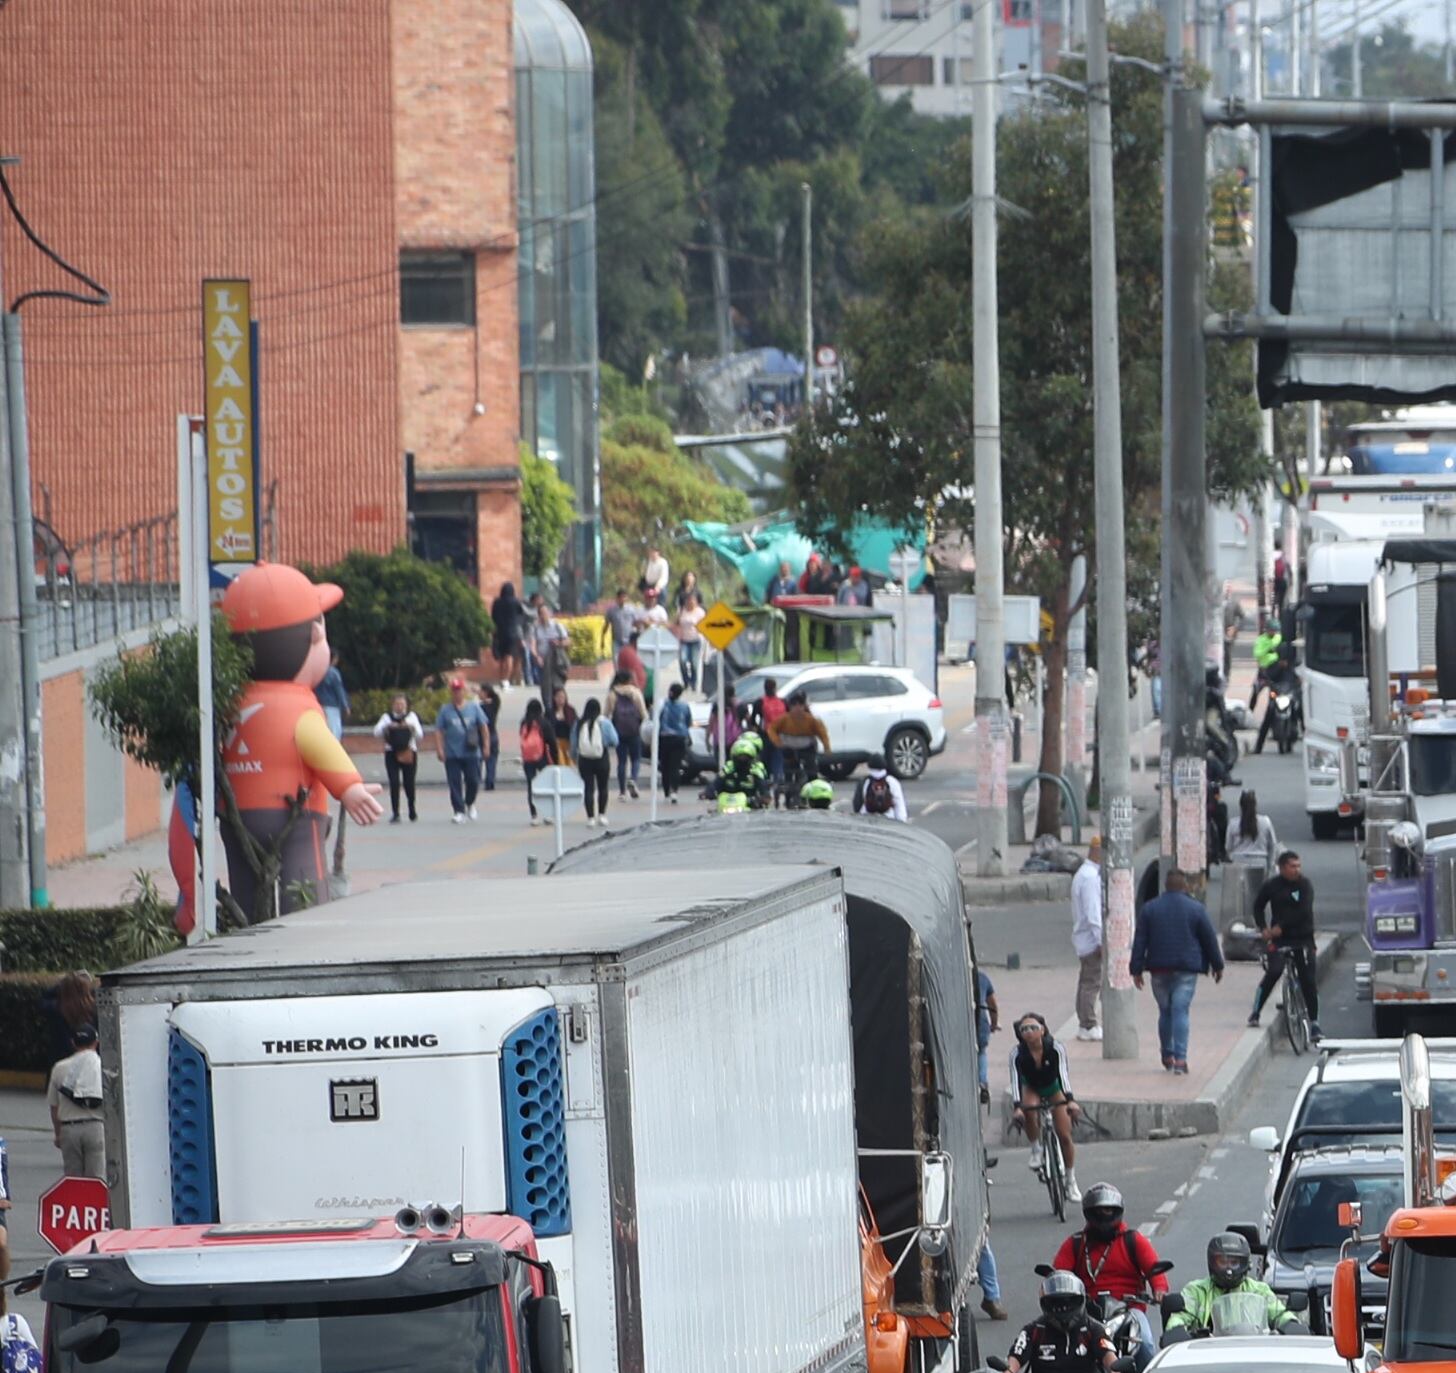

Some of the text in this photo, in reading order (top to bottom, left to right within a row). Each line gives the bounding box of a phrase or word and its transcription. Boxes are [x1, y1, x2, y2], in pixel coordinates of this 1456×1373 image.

[212, 290, 247, 520] LAVA AUTOS
[262, 1033, 439, 1054] THERMO KING
[51, 1203, 110, 1232] PARE
